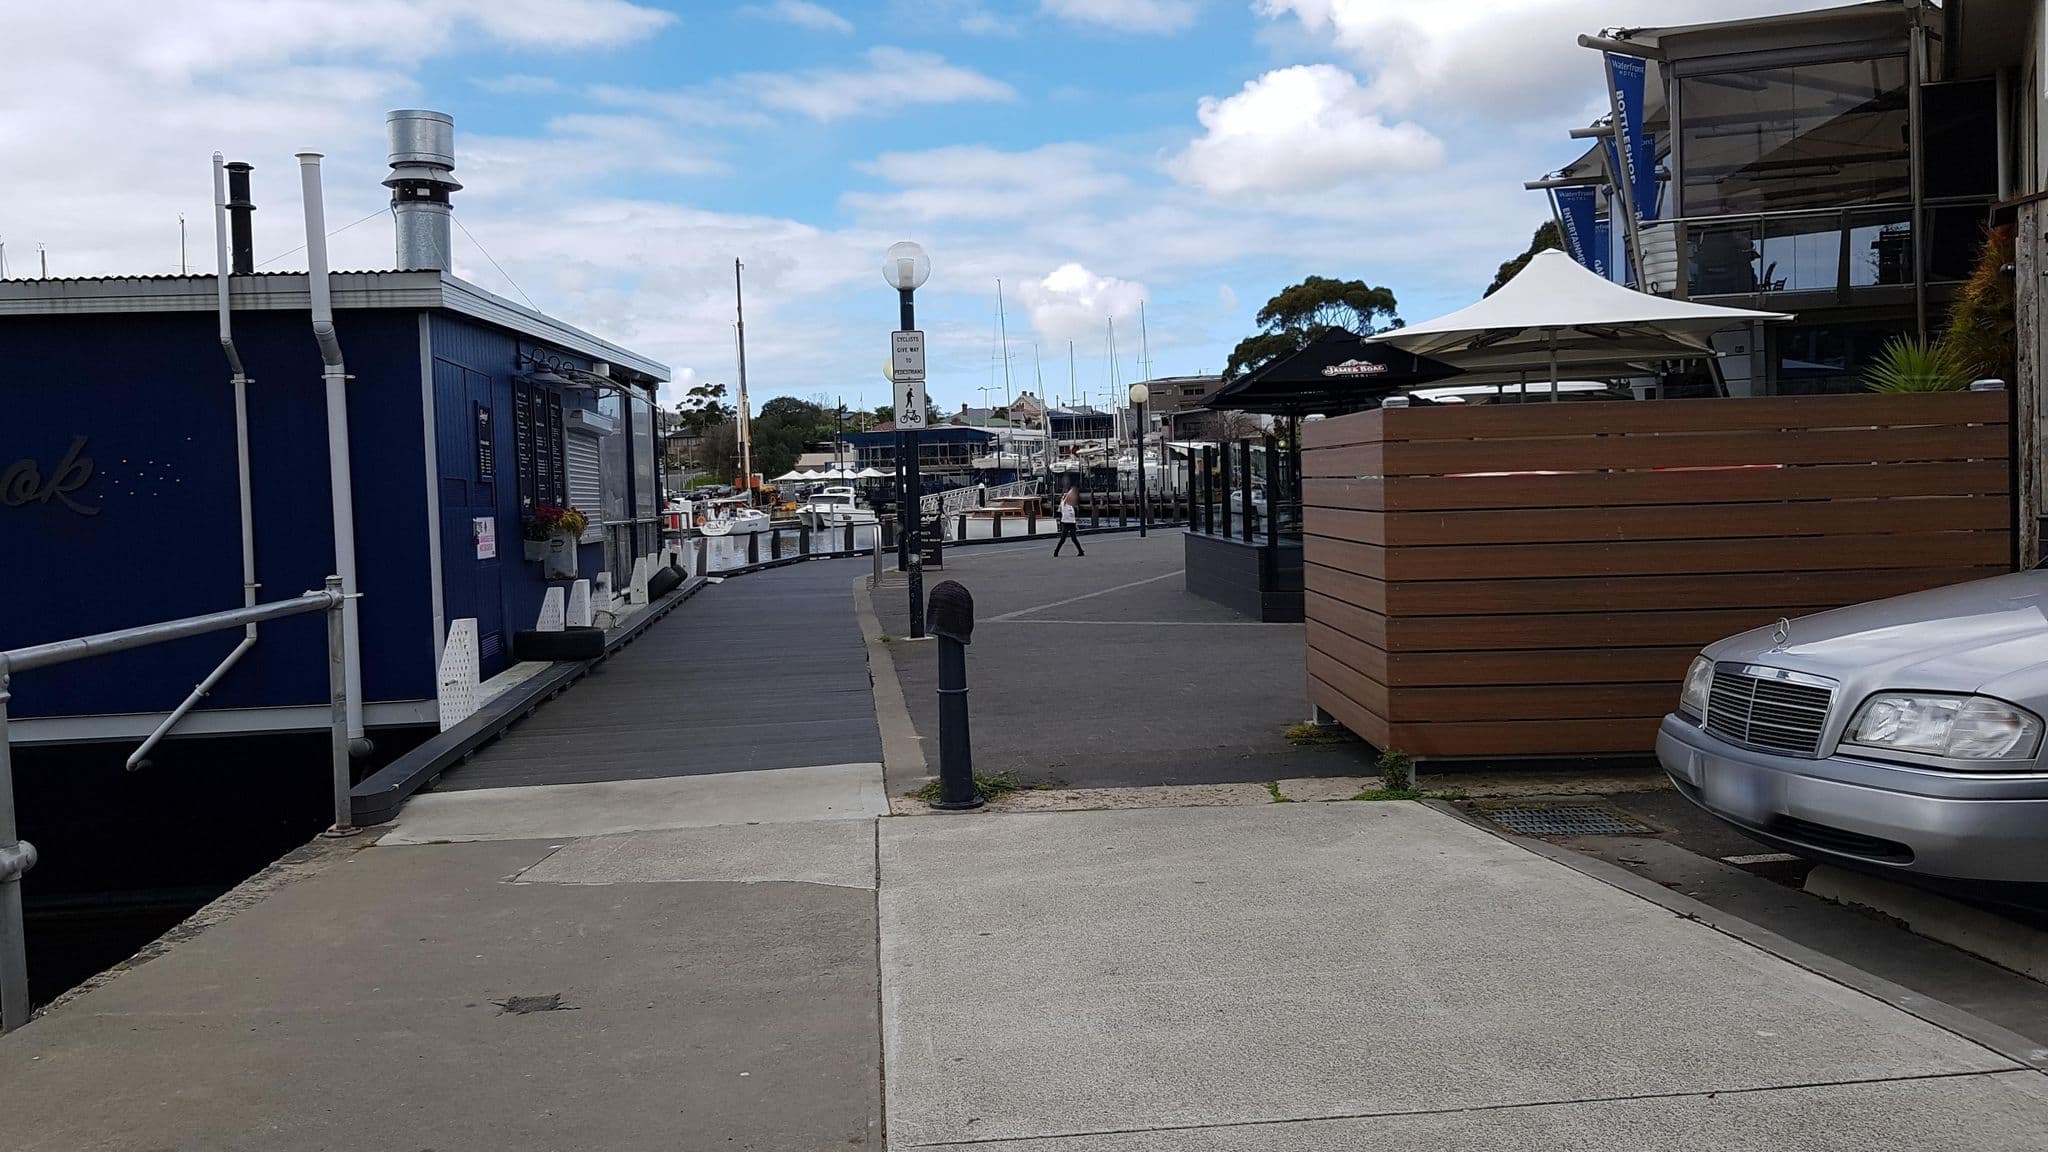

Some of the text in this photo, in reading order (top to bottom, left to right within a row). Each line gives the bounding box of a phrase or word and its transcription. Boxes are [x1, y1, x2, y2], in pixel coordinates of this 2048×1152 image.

[1611, 59, 1645, 73] Waterfront
[1616, 90, 1636, 185] BOTTLESHOP
[1562, 207, 1587, 268] ENTERTAINMEN
